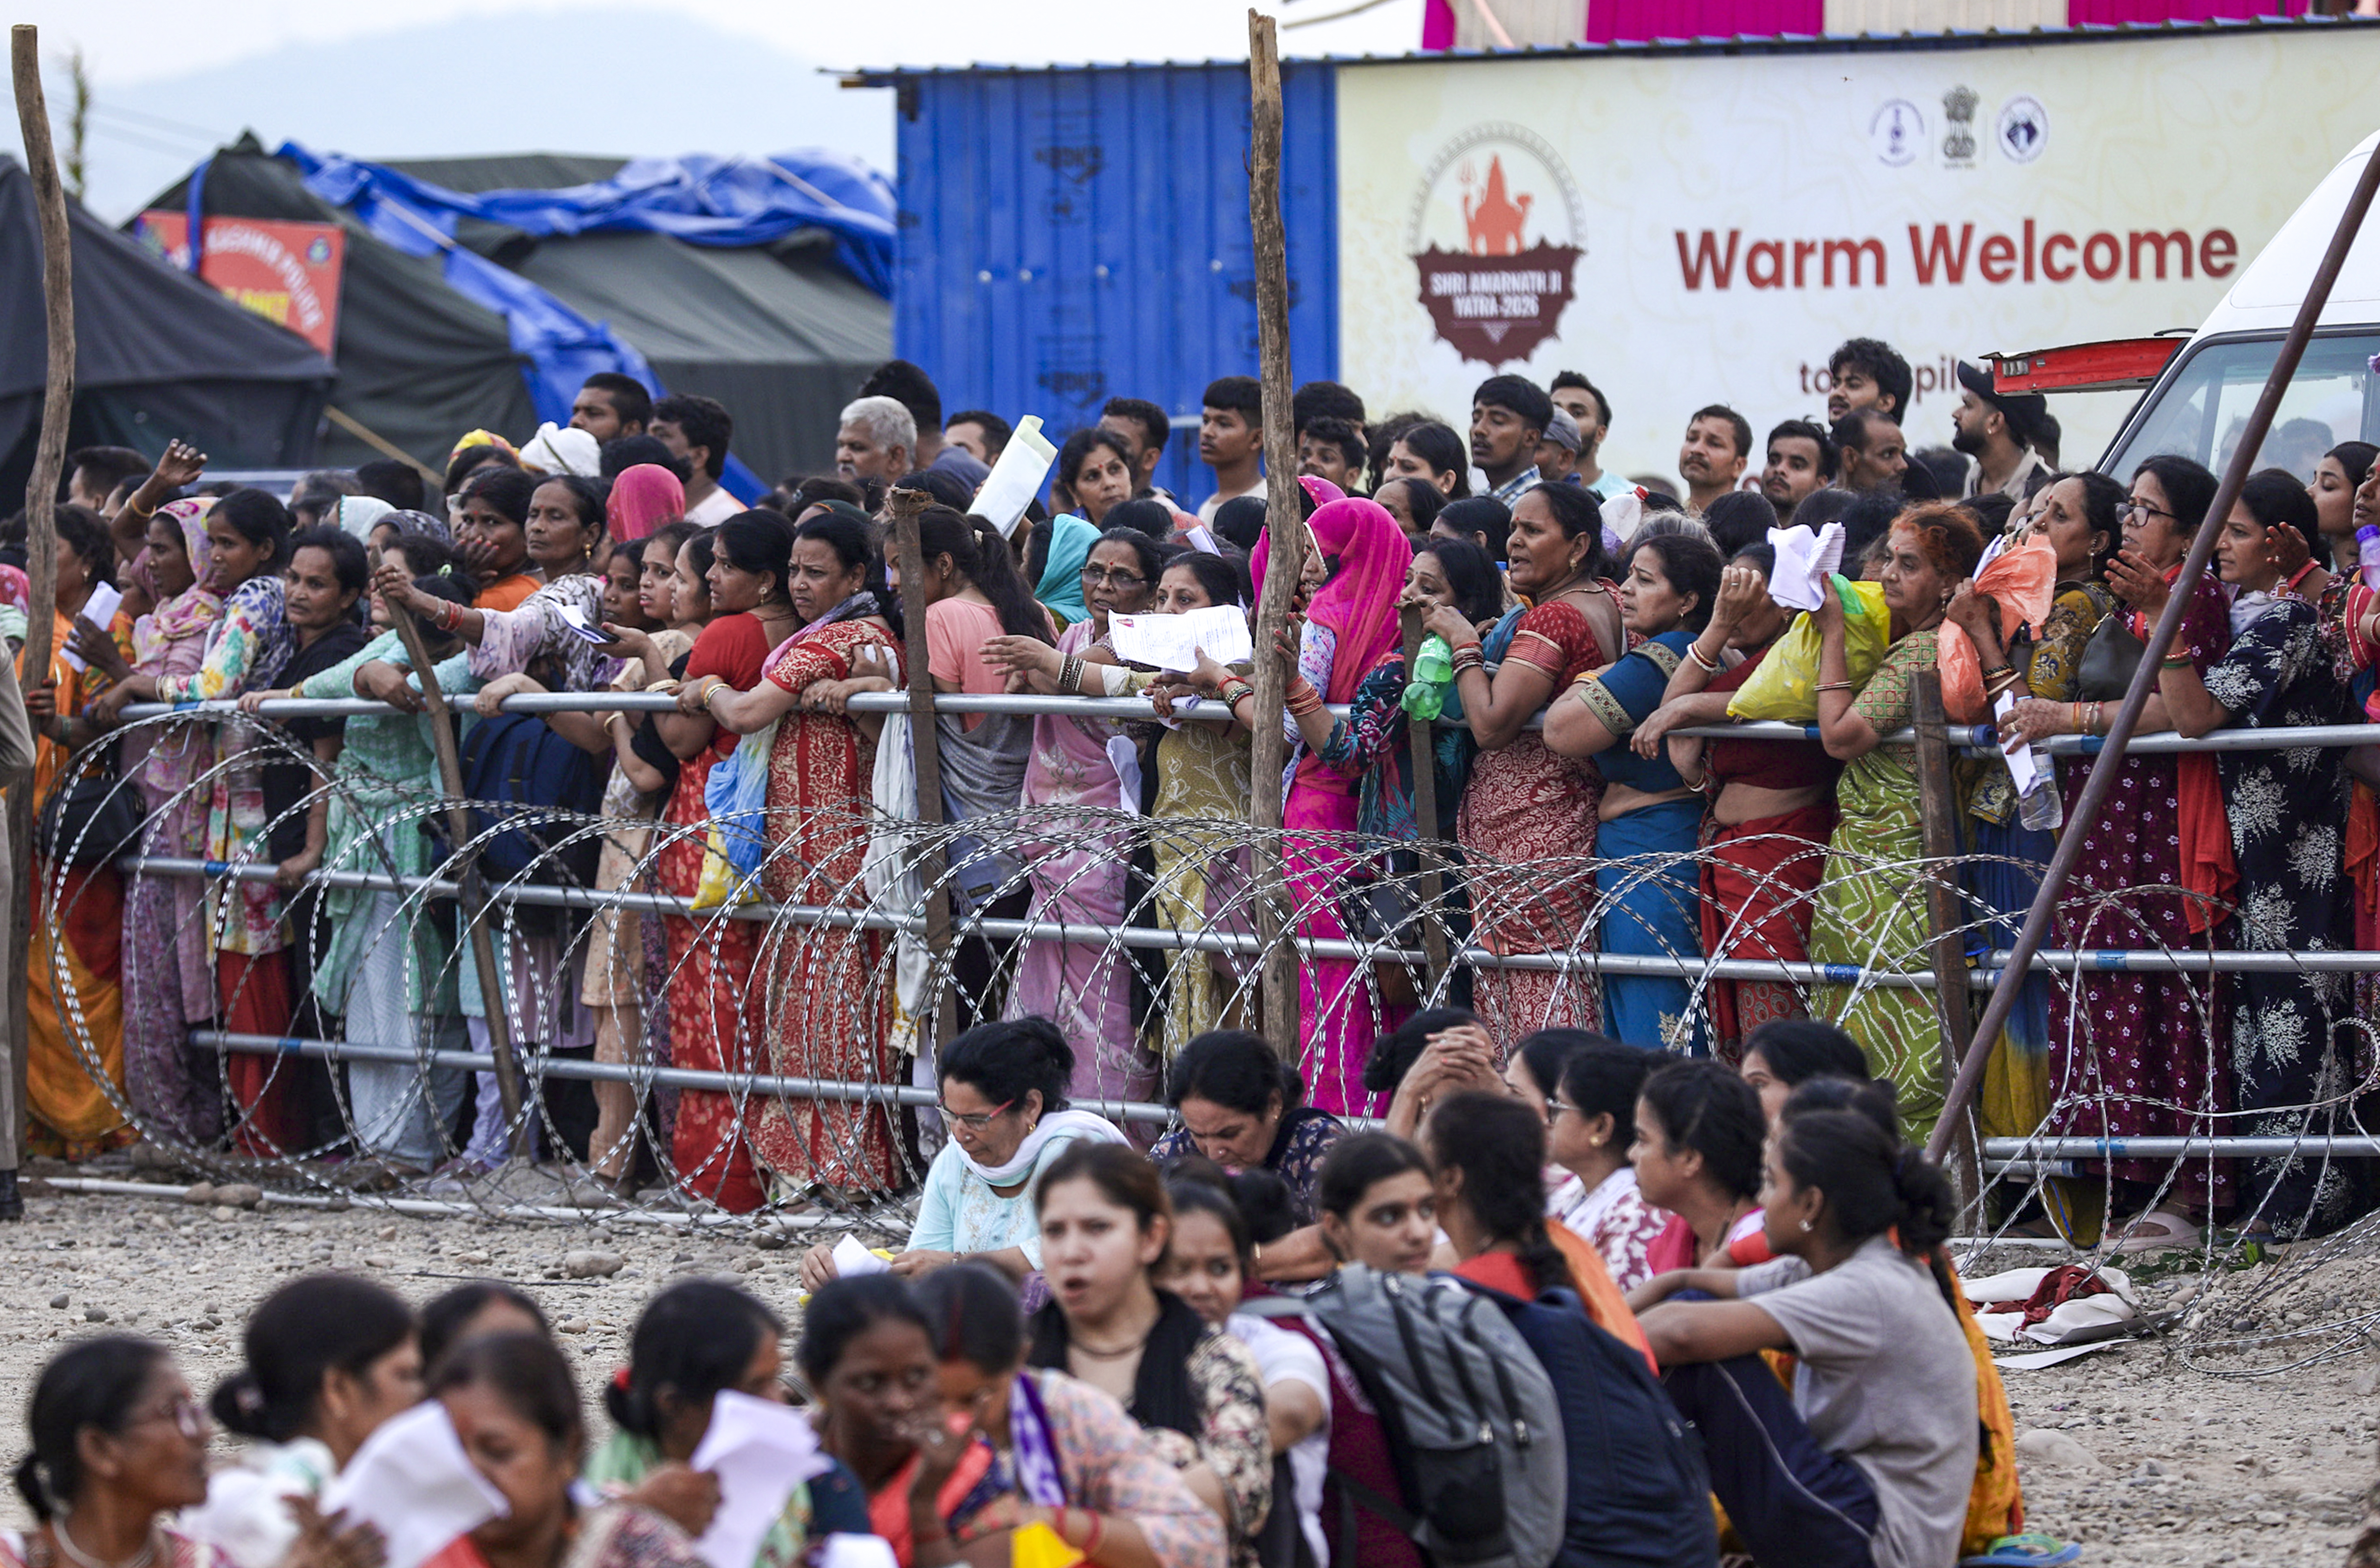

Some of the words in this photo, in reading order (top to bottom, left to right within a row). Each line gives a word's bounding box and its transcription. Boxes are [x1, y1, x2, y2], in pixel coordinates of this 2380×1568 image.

[1675, 230, 1887, 290] Warm
[1907, 217, 2238, 285] Welcome
[1430, 271, 1467, 296] SHRI
[1468, 271, 1547, 295] AMARNATH
[1547, 270, 1562, 294] JI
